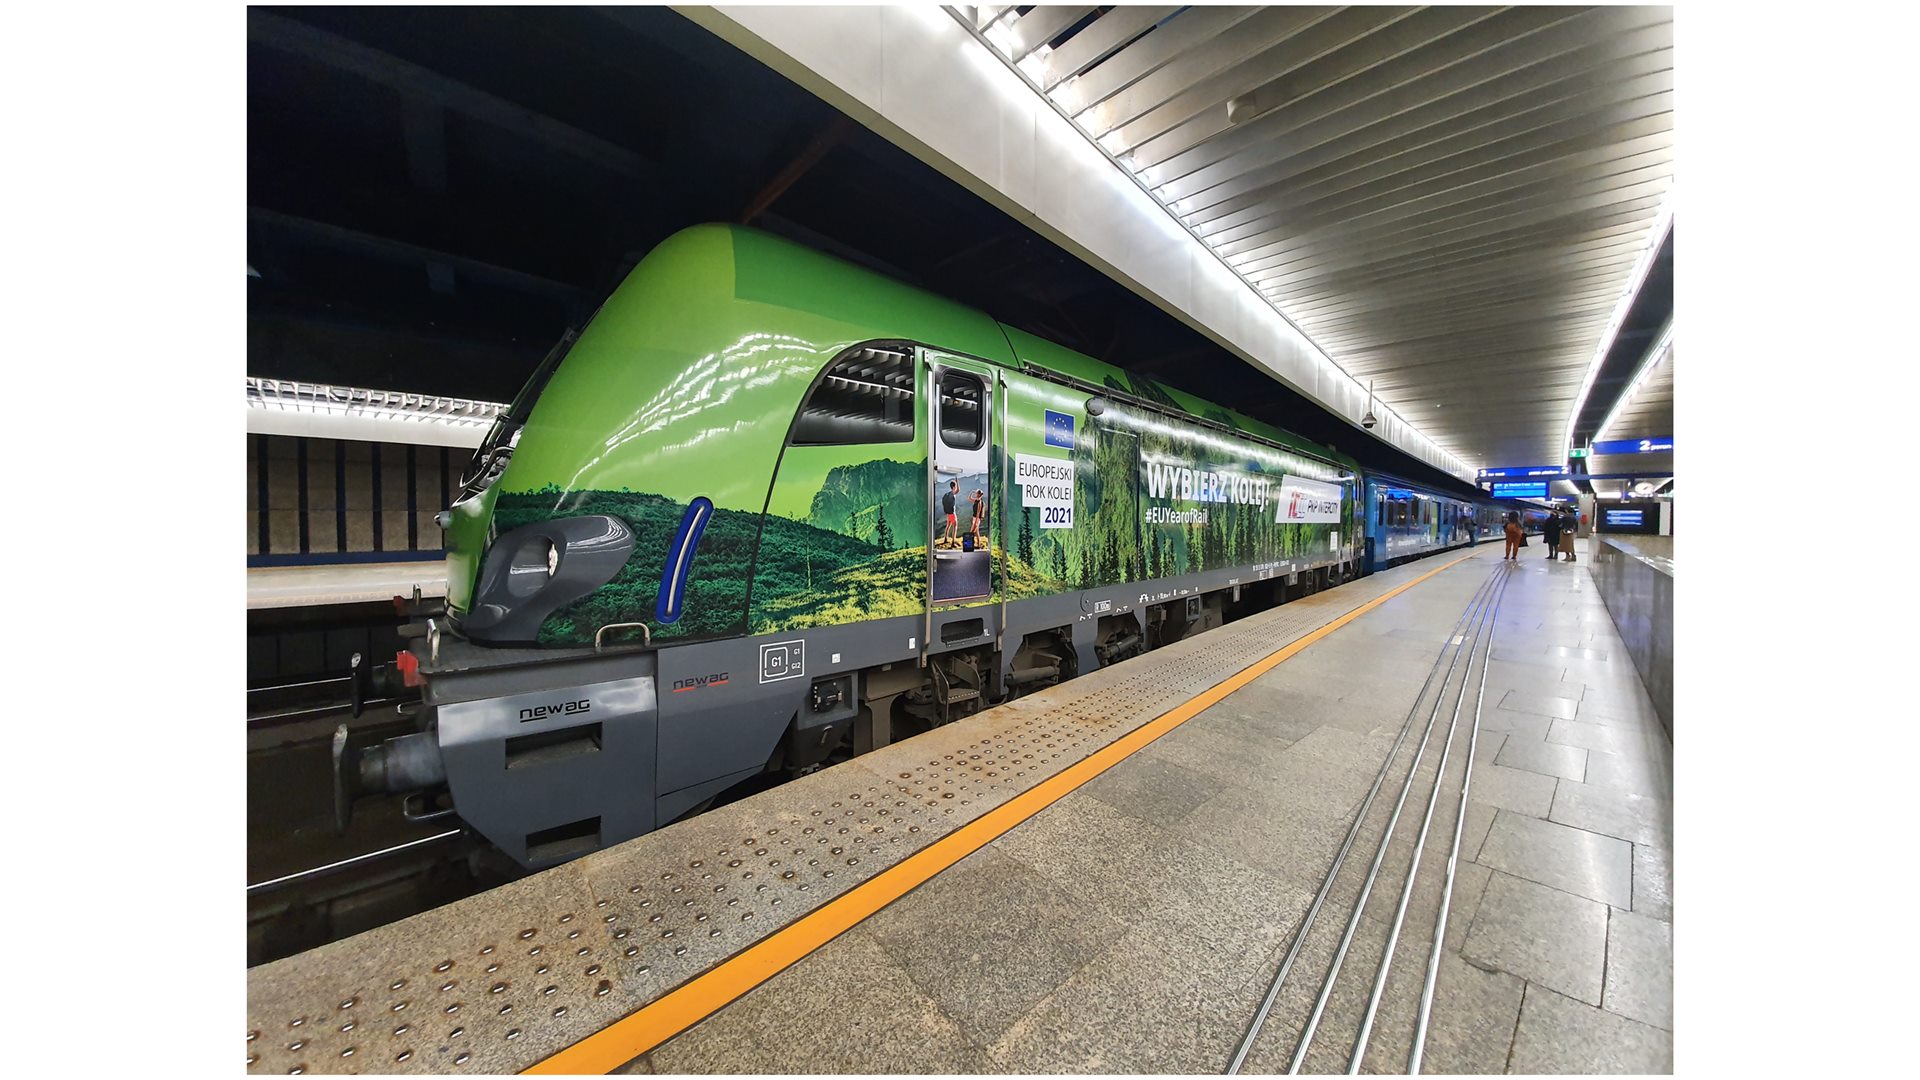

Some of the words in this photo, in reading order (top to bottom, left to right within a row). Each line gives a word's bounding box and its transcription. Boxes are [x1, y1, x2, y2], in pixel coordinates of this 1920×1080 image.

[1640, 440, 1651, 451] 2
[1019, 462, 1072, 480] EUROPEJSKI
[1026, 485, 1046, 499] ROK
[1047, 486, 1072, 500] KOLEI
[1146, 462, 1227, 503] WYBIERZ
[1230, 474, 1270, 512] KOLEJ!
[1044, 507, 1072, 523] 2021
[1145, 506, 1208, 524] #EUYearofRail
[771, 656, 782, 667] G1
[672, 672, 729, 692] newag
[519, 699, 590, 722] newag
